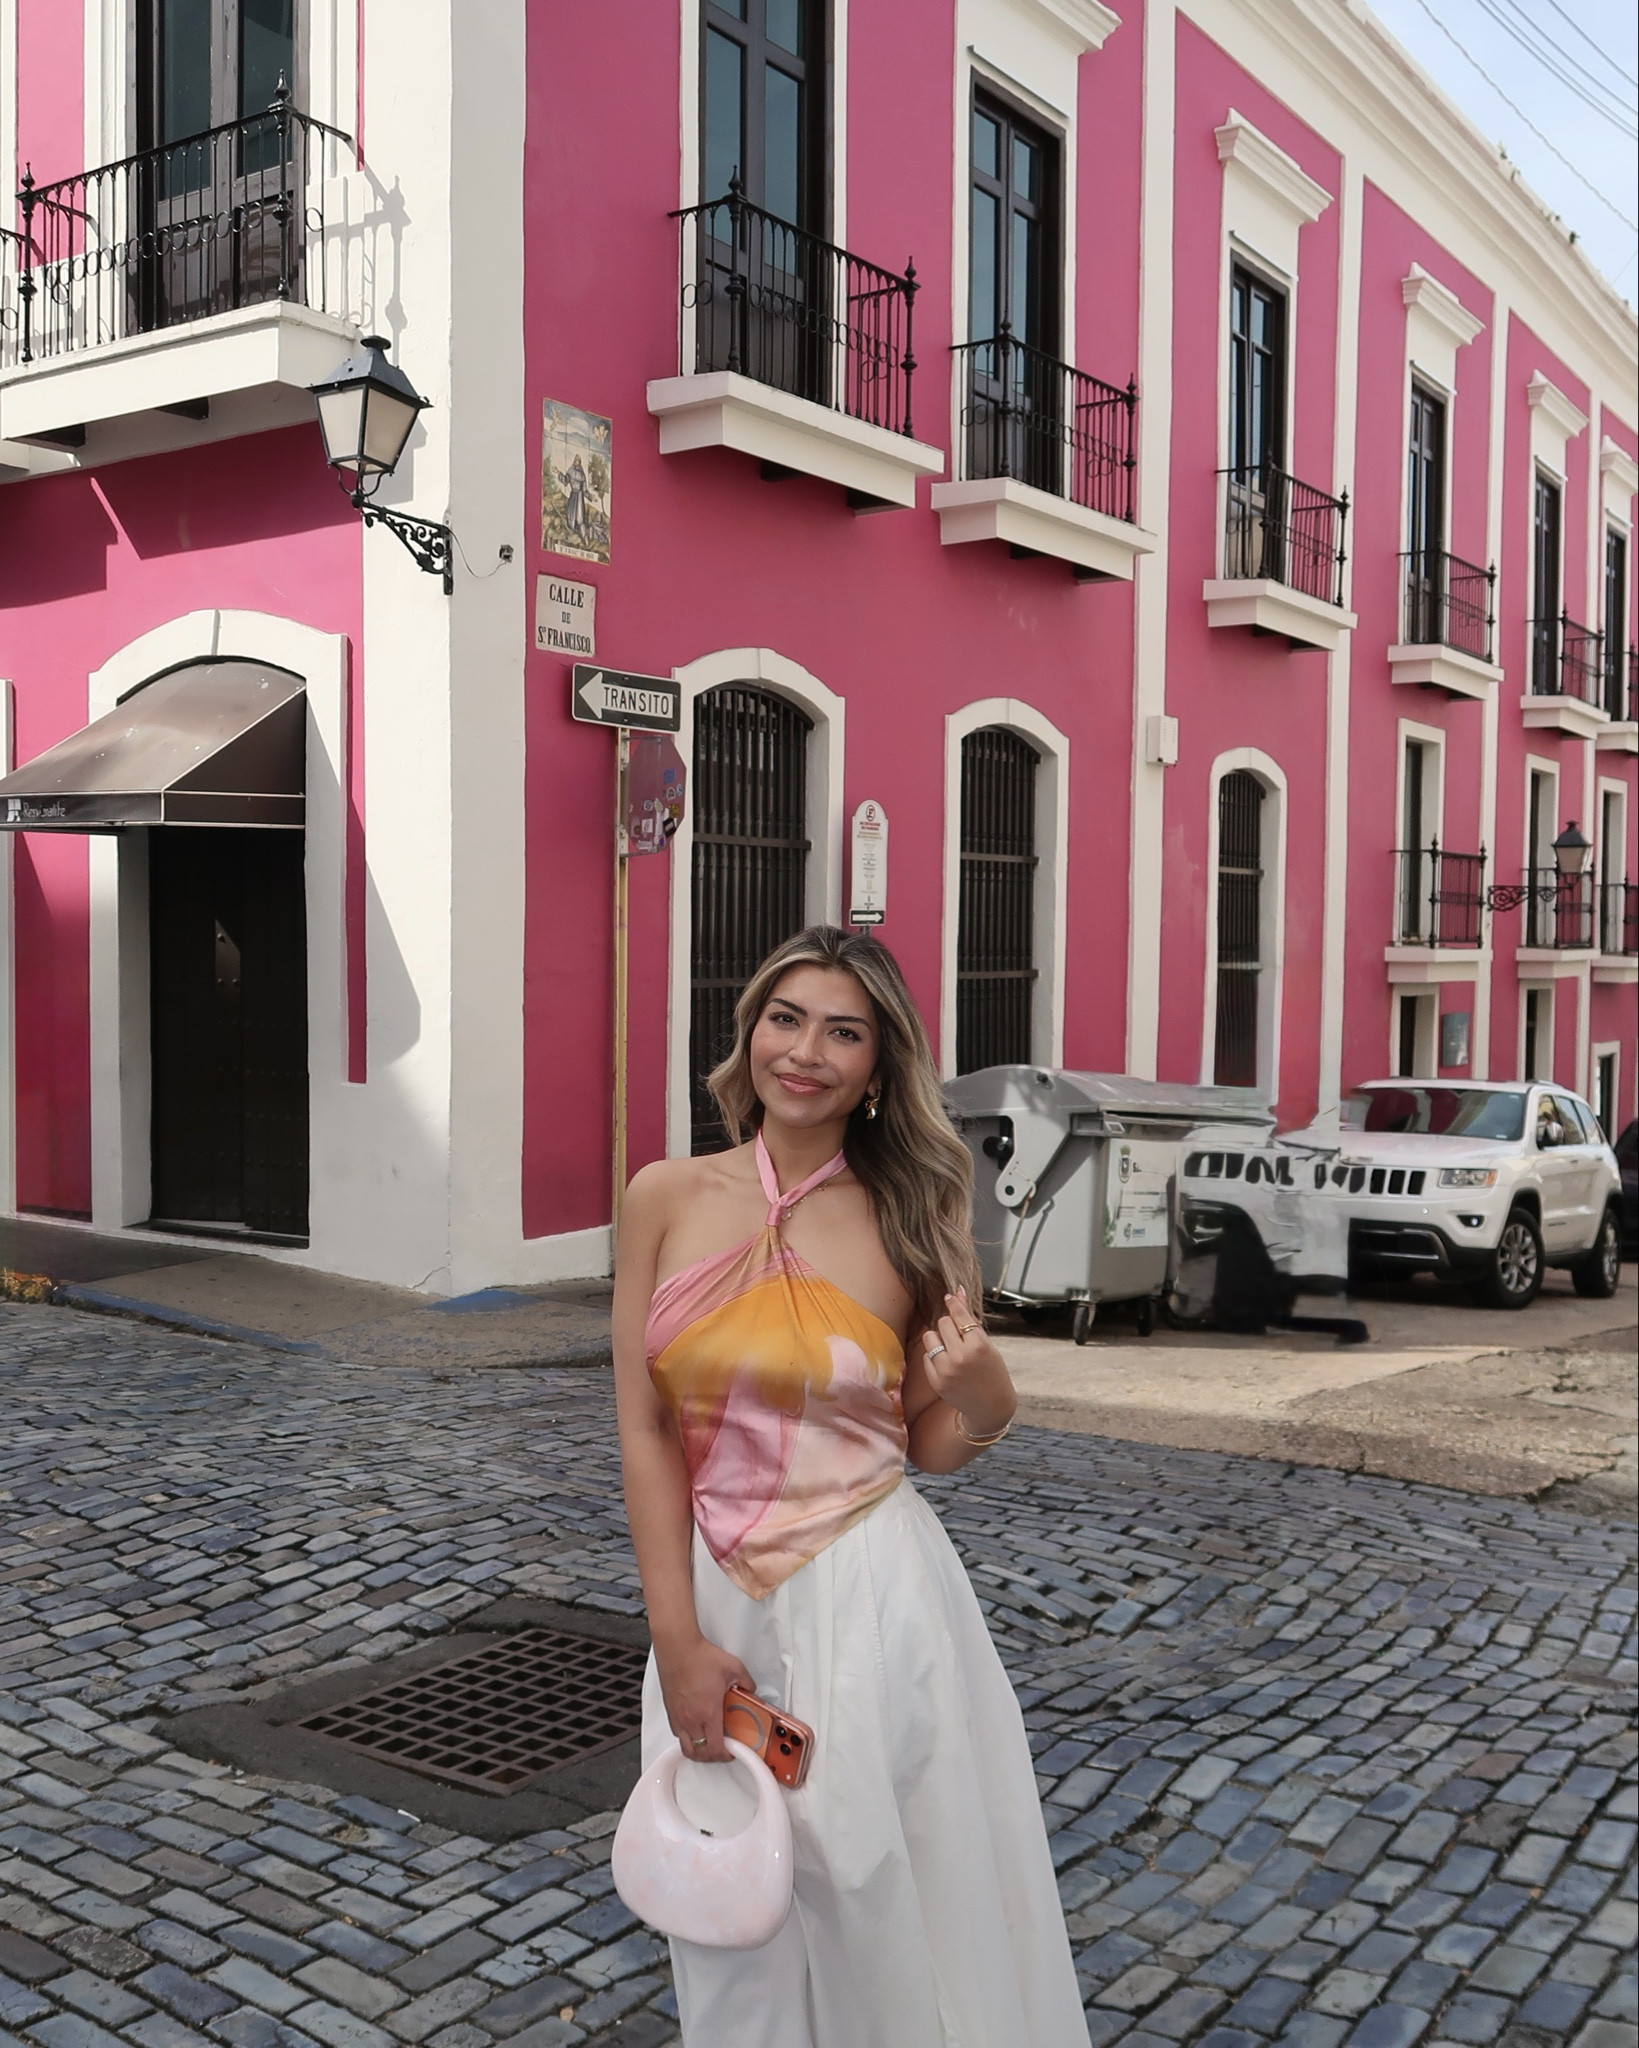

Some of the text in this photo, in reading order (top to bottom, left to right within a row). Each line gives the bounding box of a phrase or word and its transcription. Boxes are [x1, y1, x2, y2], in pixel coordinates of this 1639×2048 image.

[549, 583, 585, 608] CALLE
[561, 611, 572, 624] DE
[603, 686, 670, 715] TRANSITO
